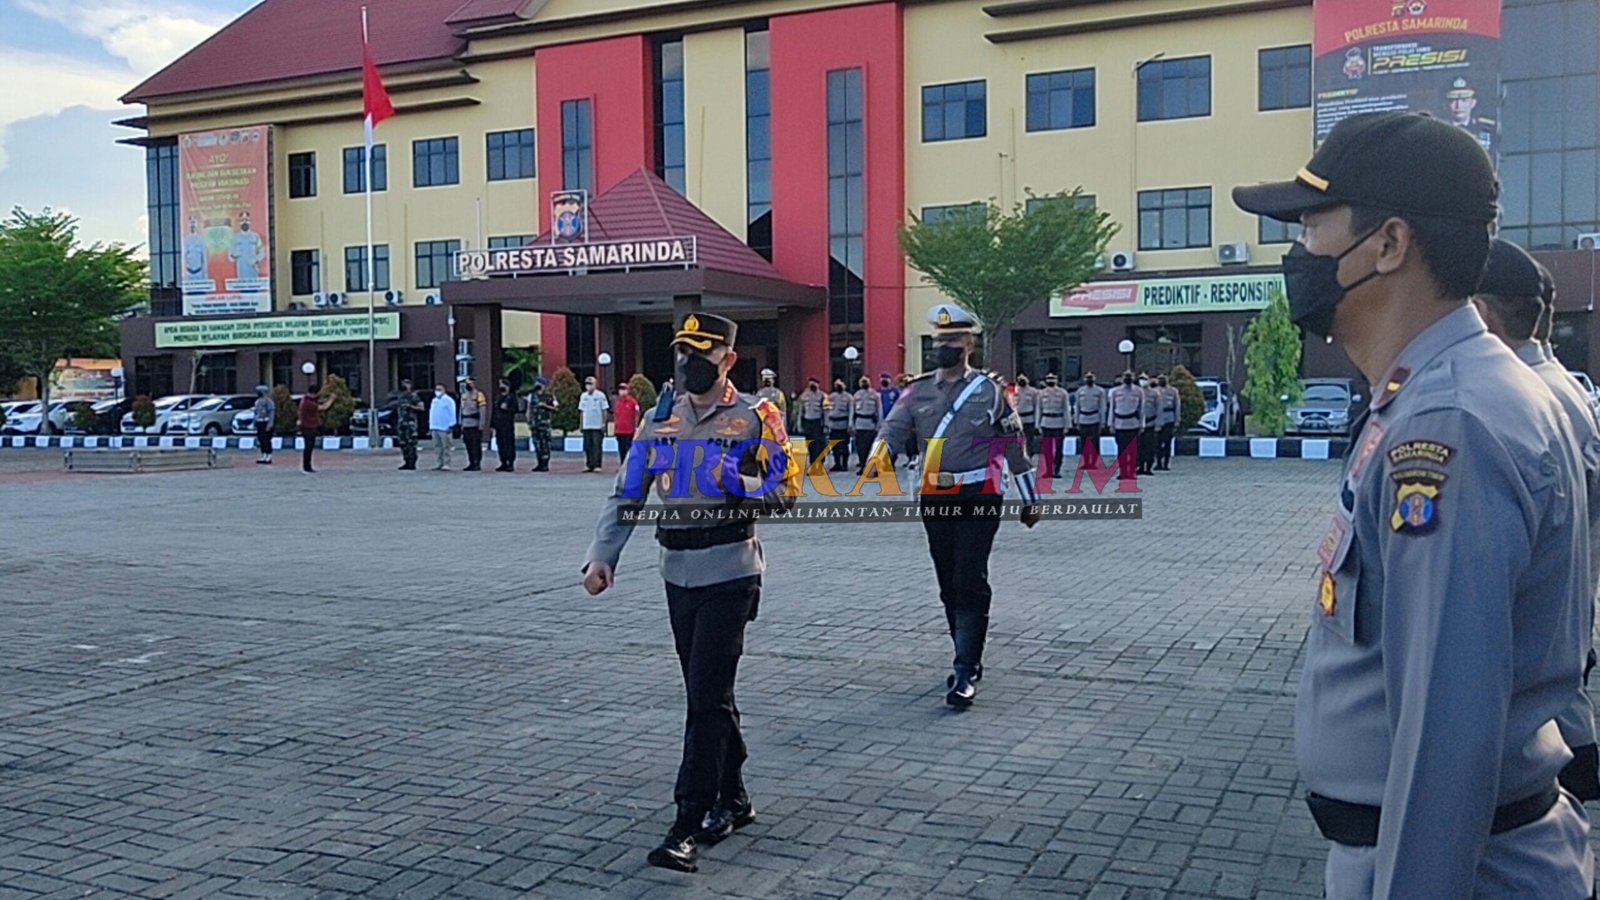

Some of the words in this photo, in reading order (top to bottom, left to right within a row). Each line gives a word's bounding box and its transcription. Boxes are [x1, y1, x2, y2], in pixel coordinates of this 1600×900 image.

[1344, 19, 1399, 43] POLRESTA
[1402, 16, 1468, 30] SAMARINDA
[1373, 49, 1468, 70] PRESISI
[459, 248, 557, 273] POLRESTA
[563, 240, 685, 266] SAMARINDA
[1143, 284, 1201, 305] PREDIKTIF
[1390, 442, 1449, 458] POLRESTA
